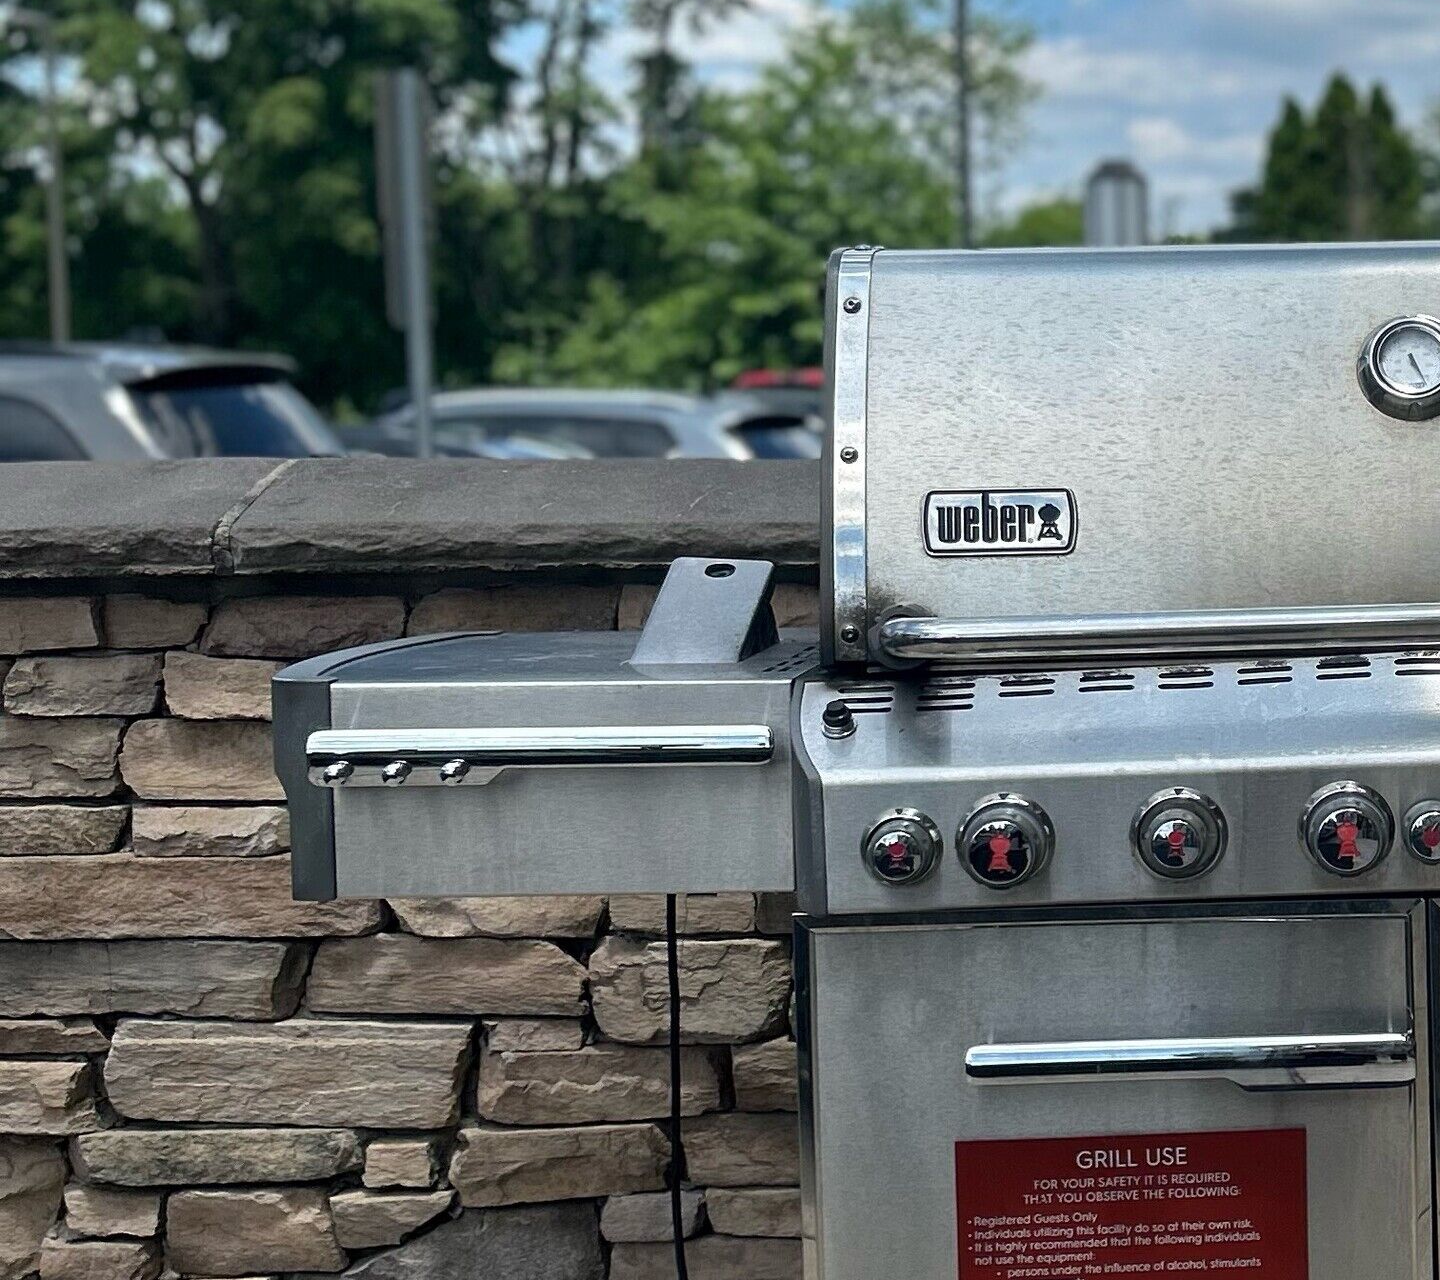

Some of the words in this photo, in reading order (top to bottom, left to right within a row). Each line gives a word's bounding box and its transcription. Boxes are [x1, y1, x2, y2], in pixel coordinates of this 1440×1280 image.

[935, 492, 1035, 544] weber
[1076, 1149, 1138, 1169] GRILL
[1146, 1147, 1187, 1166] USE
[1034, 1180, 1057, 1190] FOR
[1061, 1178, 1094, 1188] YOUR
[1098, 1176, 1140, 1187] SAFETY
[1144, 1175, 1154, 1185] IT
[1158, 1174, 1168, 1184] IS
[1172, 1172, 1230, 1184] REQUIRED
[1024, 1194, 1053, 1204] THAT
[1056, 1193, 1082, 1203] YOU
[1086, 1191, 1139, 1202] OBSERVE
[1143, 1189, 1164, 1199] THE
[974, 1214, 1030, 1228] Registered
[1034, 1213, 1070, 1223] Guests
[1073, 1212, 1097, 1223] Only
[1034, 1227, 1073, 1238] utilizing
[1077, 1226, 1094, 1235] this
[1098, 1224, 1132, 1235] facility
[1135, 1224, 1149, 1233] do
[1168, 1222, 1179, 1231] at
[1182, 1221, 1205, 1230] their
[975, 1243, 982, 1252] It
[985, 1243, 992, 1251] is
[996, 1242, 1027, 1253] highly
[1030, 1238, 1107, 1250] recommended
[1110, 1236, 1131, 1246] that
[1135, 1236, 1151, 1246] the
[1155, 1234, 1202, 1246] following
[975, 1256, 993, 1266] not
[995, 1256, 1014, 1265] use
[1017, 1255, 1034, 1264] the
[1037, 1252, 1096, 1264] equipment:
[1007, 1268, 1049, 1278] persons
[1052, 1266, 1082, 1275] under
[1085, 1265, 1101, 1274] the
[1104, 1262, 1151, 1273] influence
[1154, 1261, 1165, 1271] of
[1167, 1260, 1207, 1271] alcohol,
[1210, 1257, 1261, 1268] stimulants
